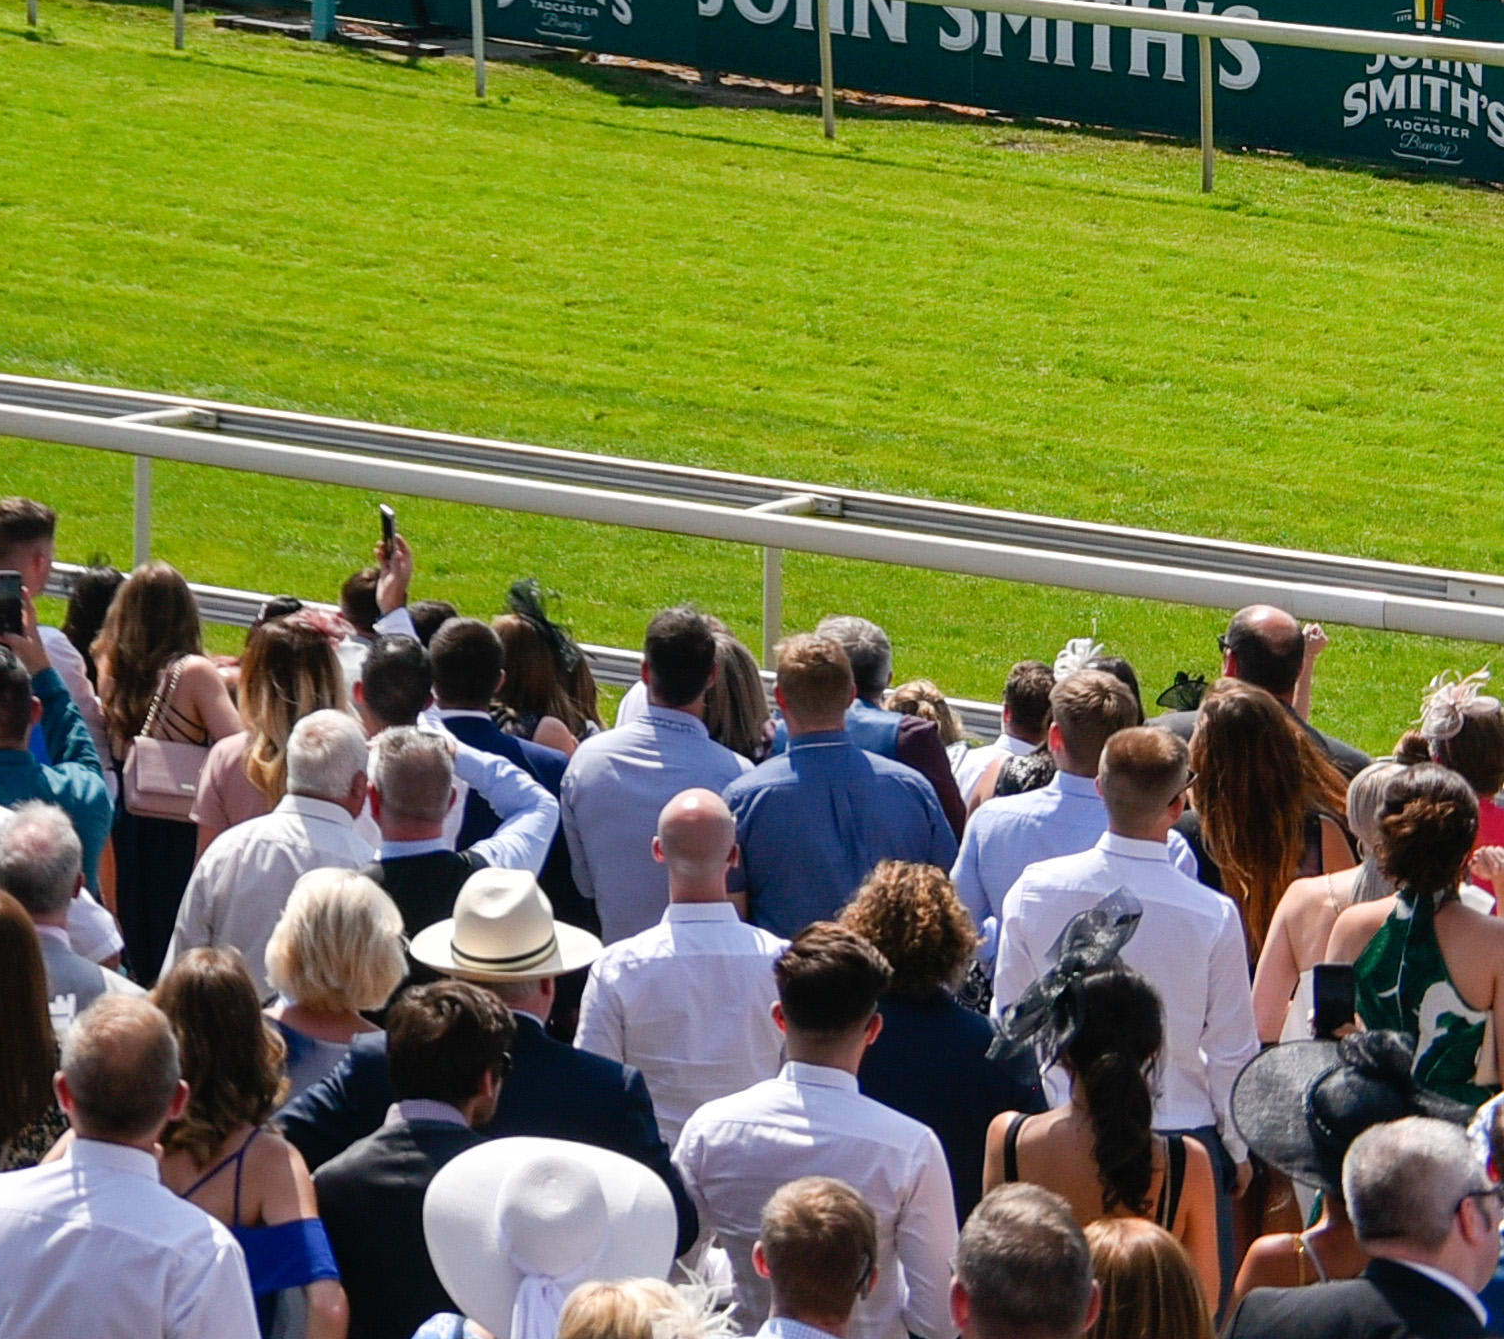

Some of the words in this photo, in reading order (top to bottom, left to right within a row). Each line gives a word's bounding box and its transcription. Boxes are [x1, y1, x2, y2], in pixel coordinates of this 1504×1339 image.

[529, 0, 600, 17] TADCASTER
[1343, 74, 1504, 149] SMITH'S
[1384, 118, 1470, 139] TADCASTER
